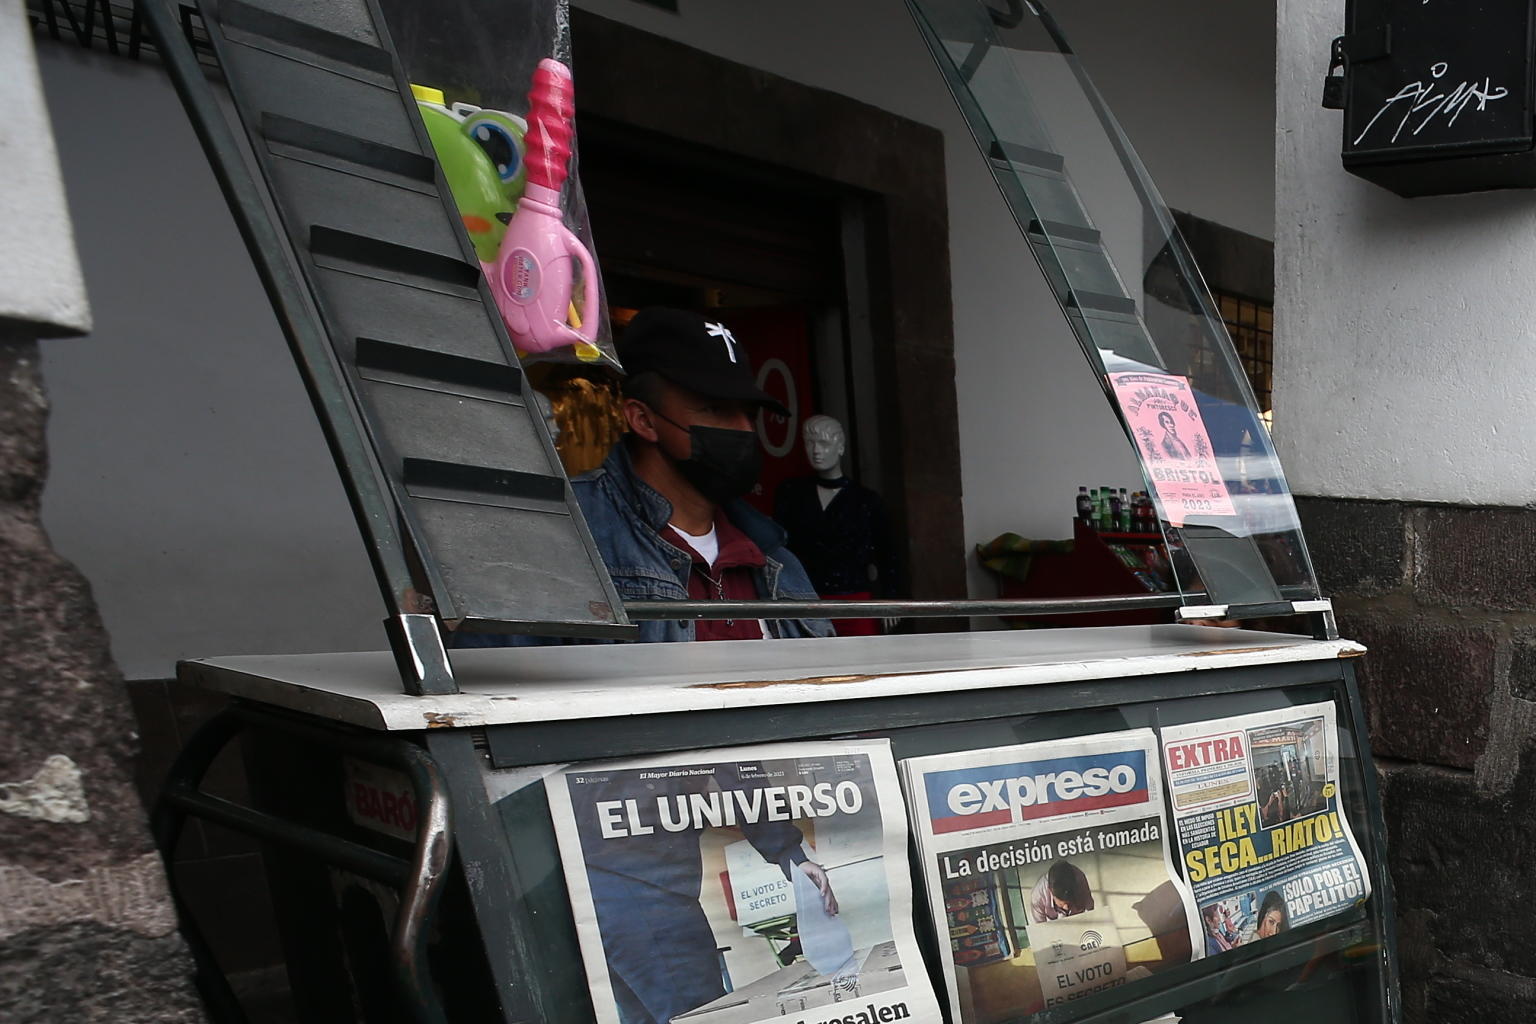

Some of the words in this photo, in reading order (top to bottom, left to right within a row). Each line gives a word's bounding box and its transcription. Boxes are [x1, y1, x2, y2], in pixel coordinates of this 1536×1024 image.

[1153, 467, 1221, 485] BRISTOL
[1182, 498, 1212, 510] 2023
[1168, 736, 1244, 770] EXTRA
[689, 767, 716, 776] Nacional
[596, 799, 654, 839] EL
[656, 780, 863, 832] UNIVERSO
[947, 764, 1136, 822] expreso
[1216, 803, 1257, 841] ¡LEY
[944, 856, 972, 879] La
[976, 838, 1052, 872] decisión
[1058, 830, 1094, 857] está
[1099, 821, 1160, 849] tomada
[741, 890, 751, 900] EL
[753, 883, 775, 896] VOTO
[777, 880, 788, 889] ES
[1282, 876, 1315, 902] ¡SOLO
[1314, 868, 1343, 890] POR
[1342, 862, 1360, 881] EL
[1287, 878, 1363, 918] PAPELITO!
[750, 893, 787, 911] SECRETO
[1056, 974, 1075, 989] EL
[1076, 962, 1113, 983] VOTO
